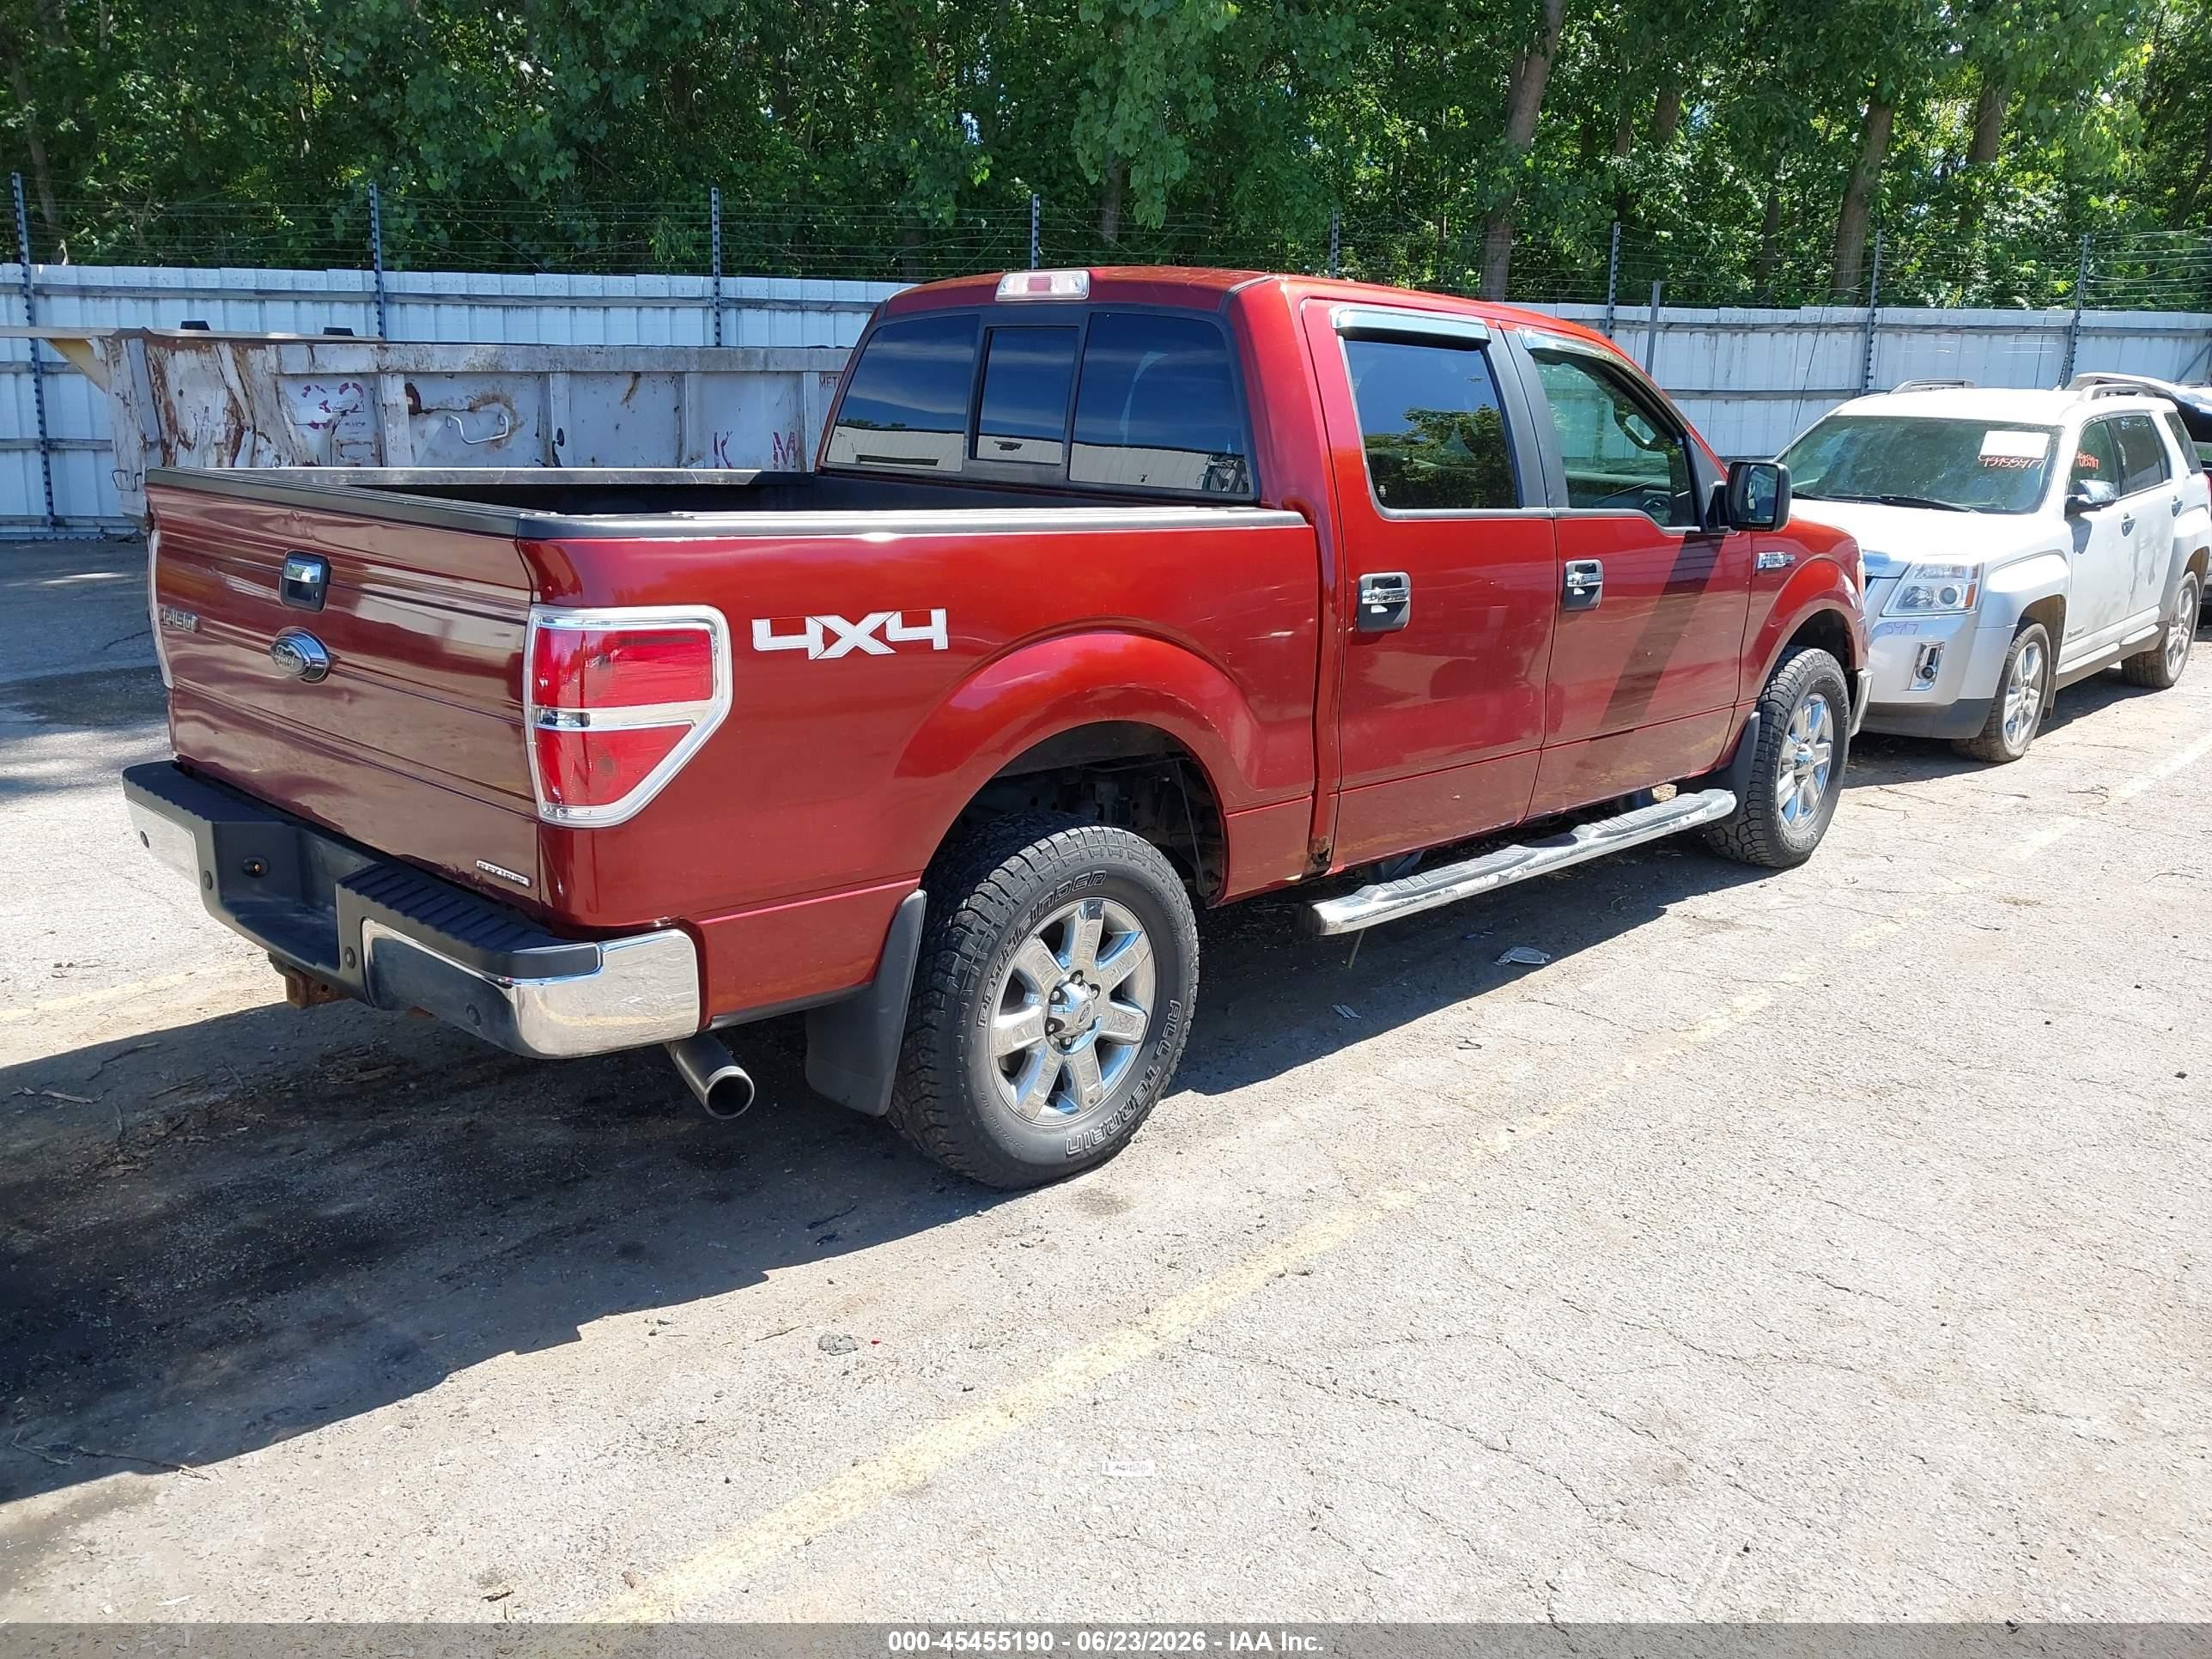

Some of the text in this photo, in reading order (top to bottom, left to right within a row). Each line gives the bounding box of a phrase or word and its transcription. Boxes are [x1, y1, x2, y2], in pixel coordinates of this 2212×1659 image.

[975, 869, 1107, 1029] PATHFINDER
[1154, 999, 1182, 1060] ALL
[1065, 1065, 1161, 1158] TERRAIN
